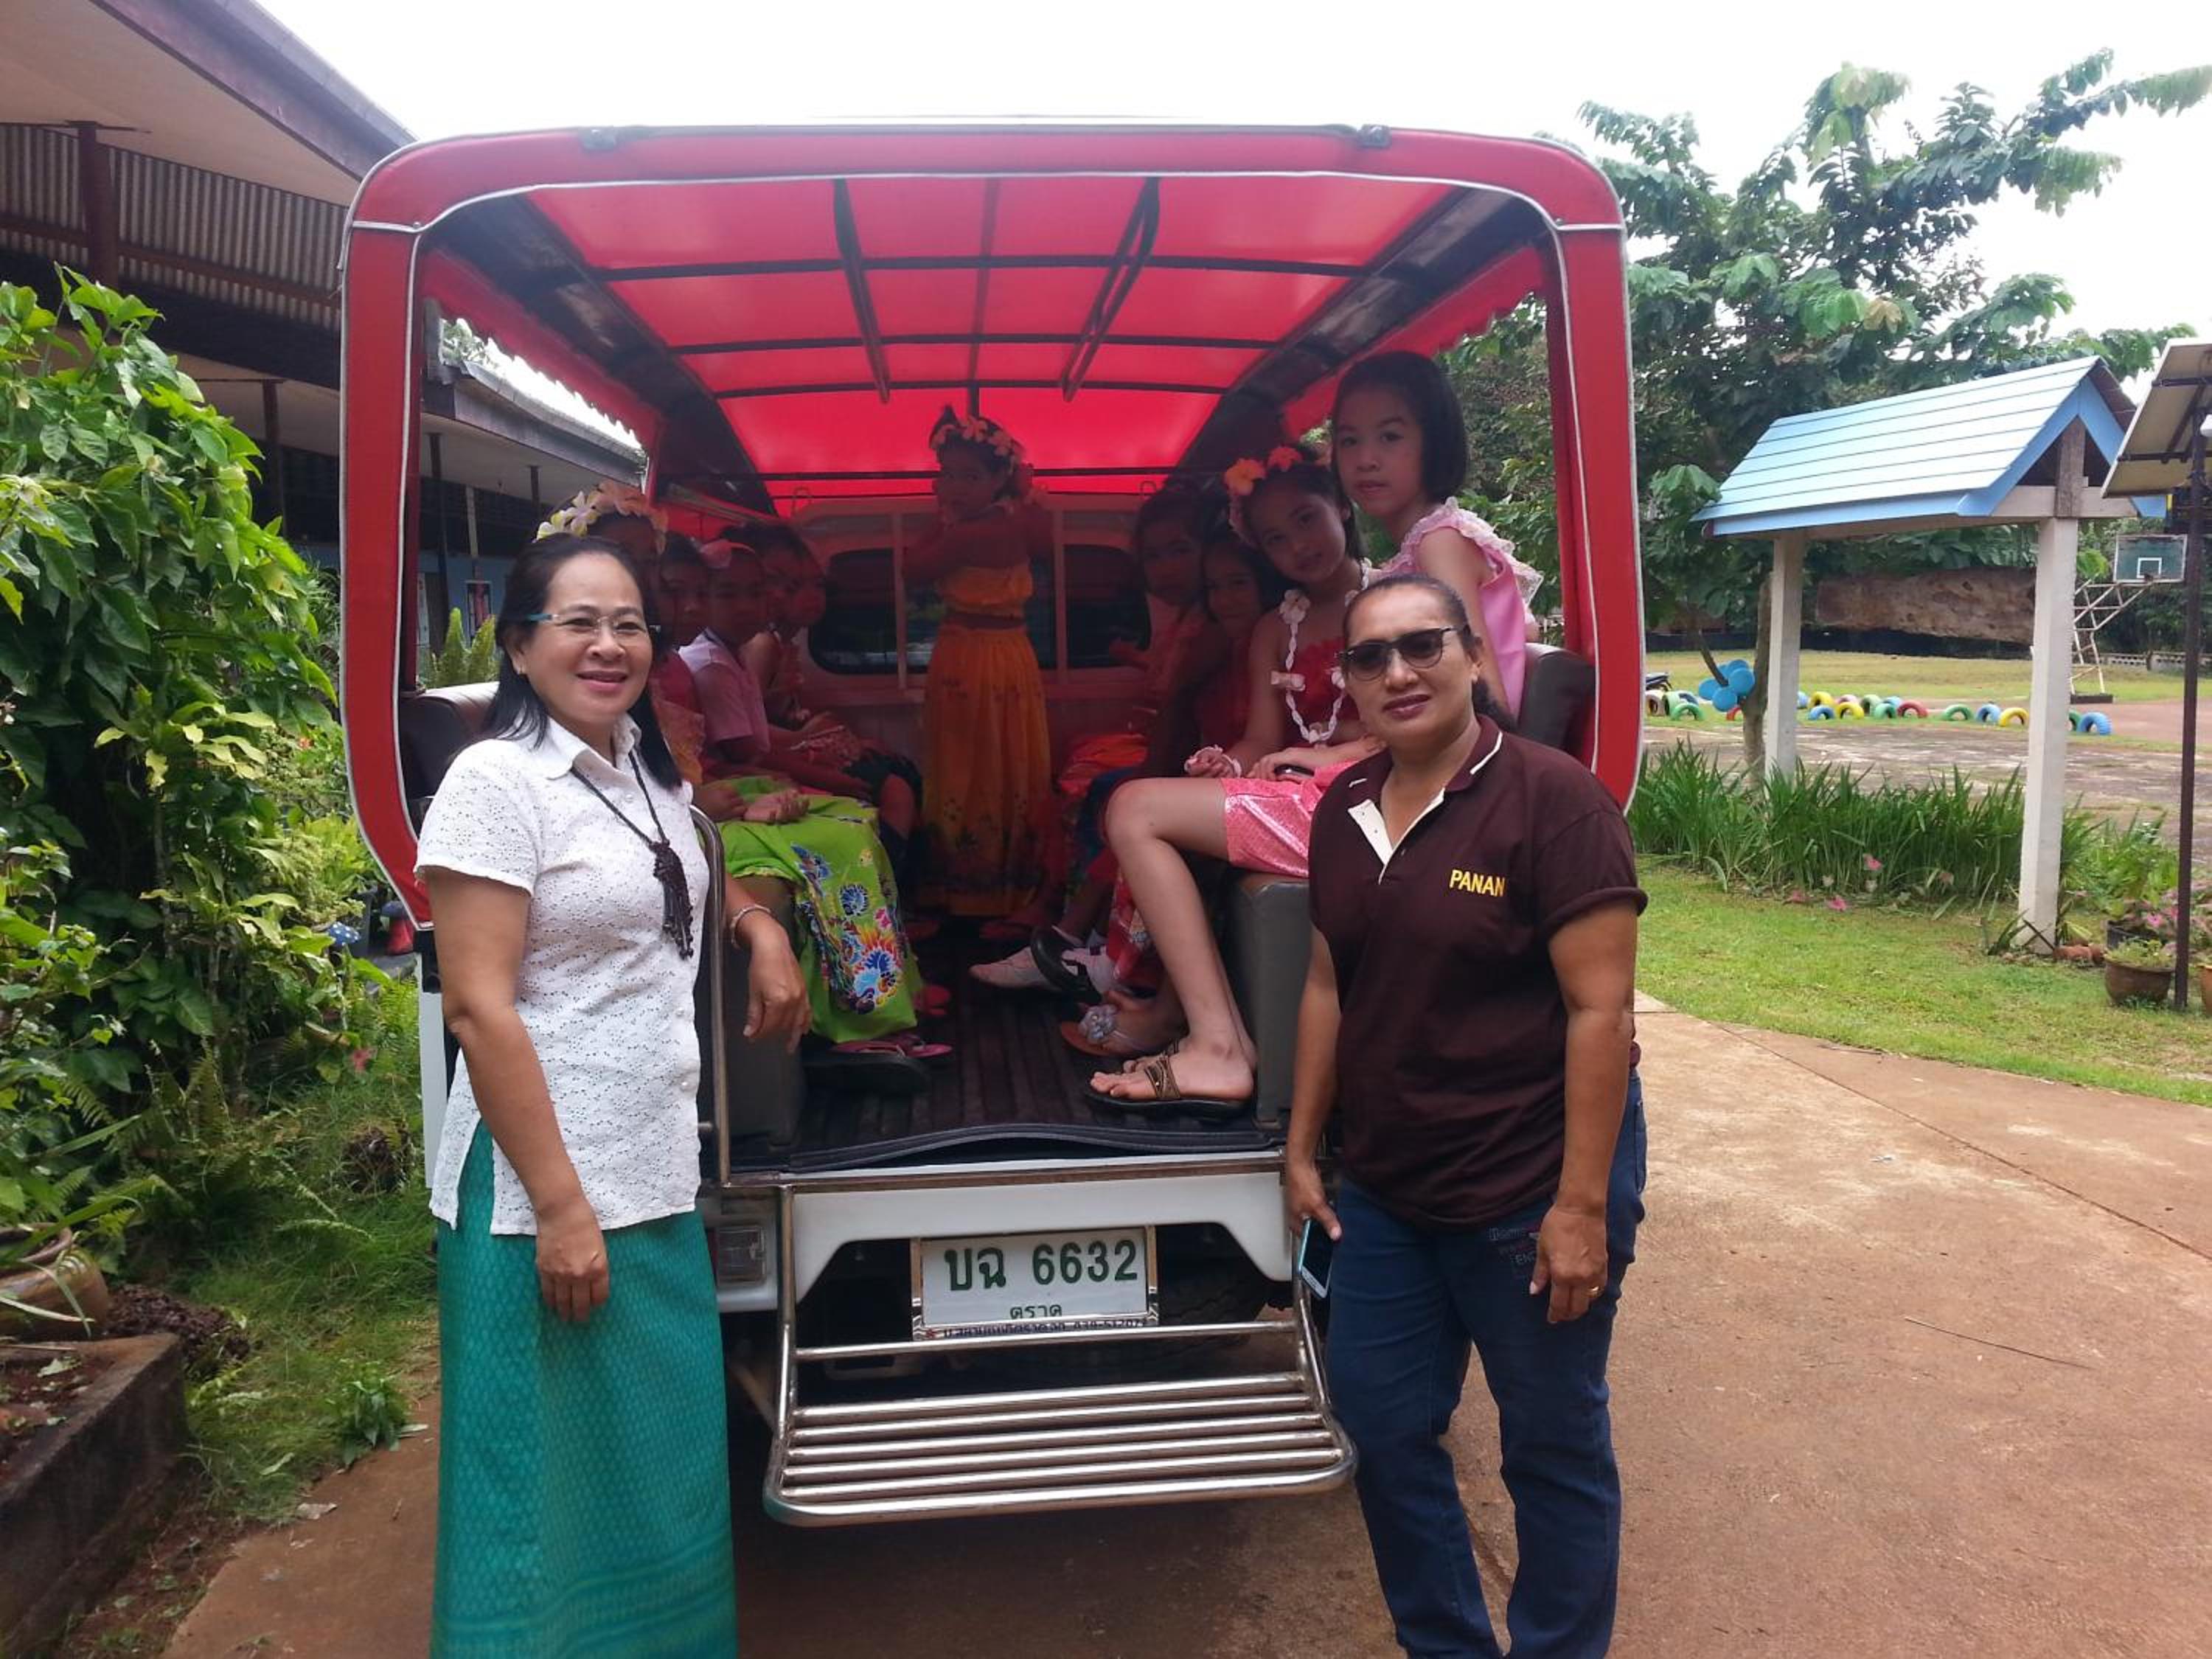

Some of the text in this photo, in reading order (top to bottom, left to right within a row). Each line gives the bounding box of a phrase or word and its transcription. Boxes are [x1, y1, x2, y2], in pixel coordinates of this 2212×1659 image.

[944, 1239, 1138, 1292] บฉ 6632
[1009, 1304, 1062, 1319] ตราด
